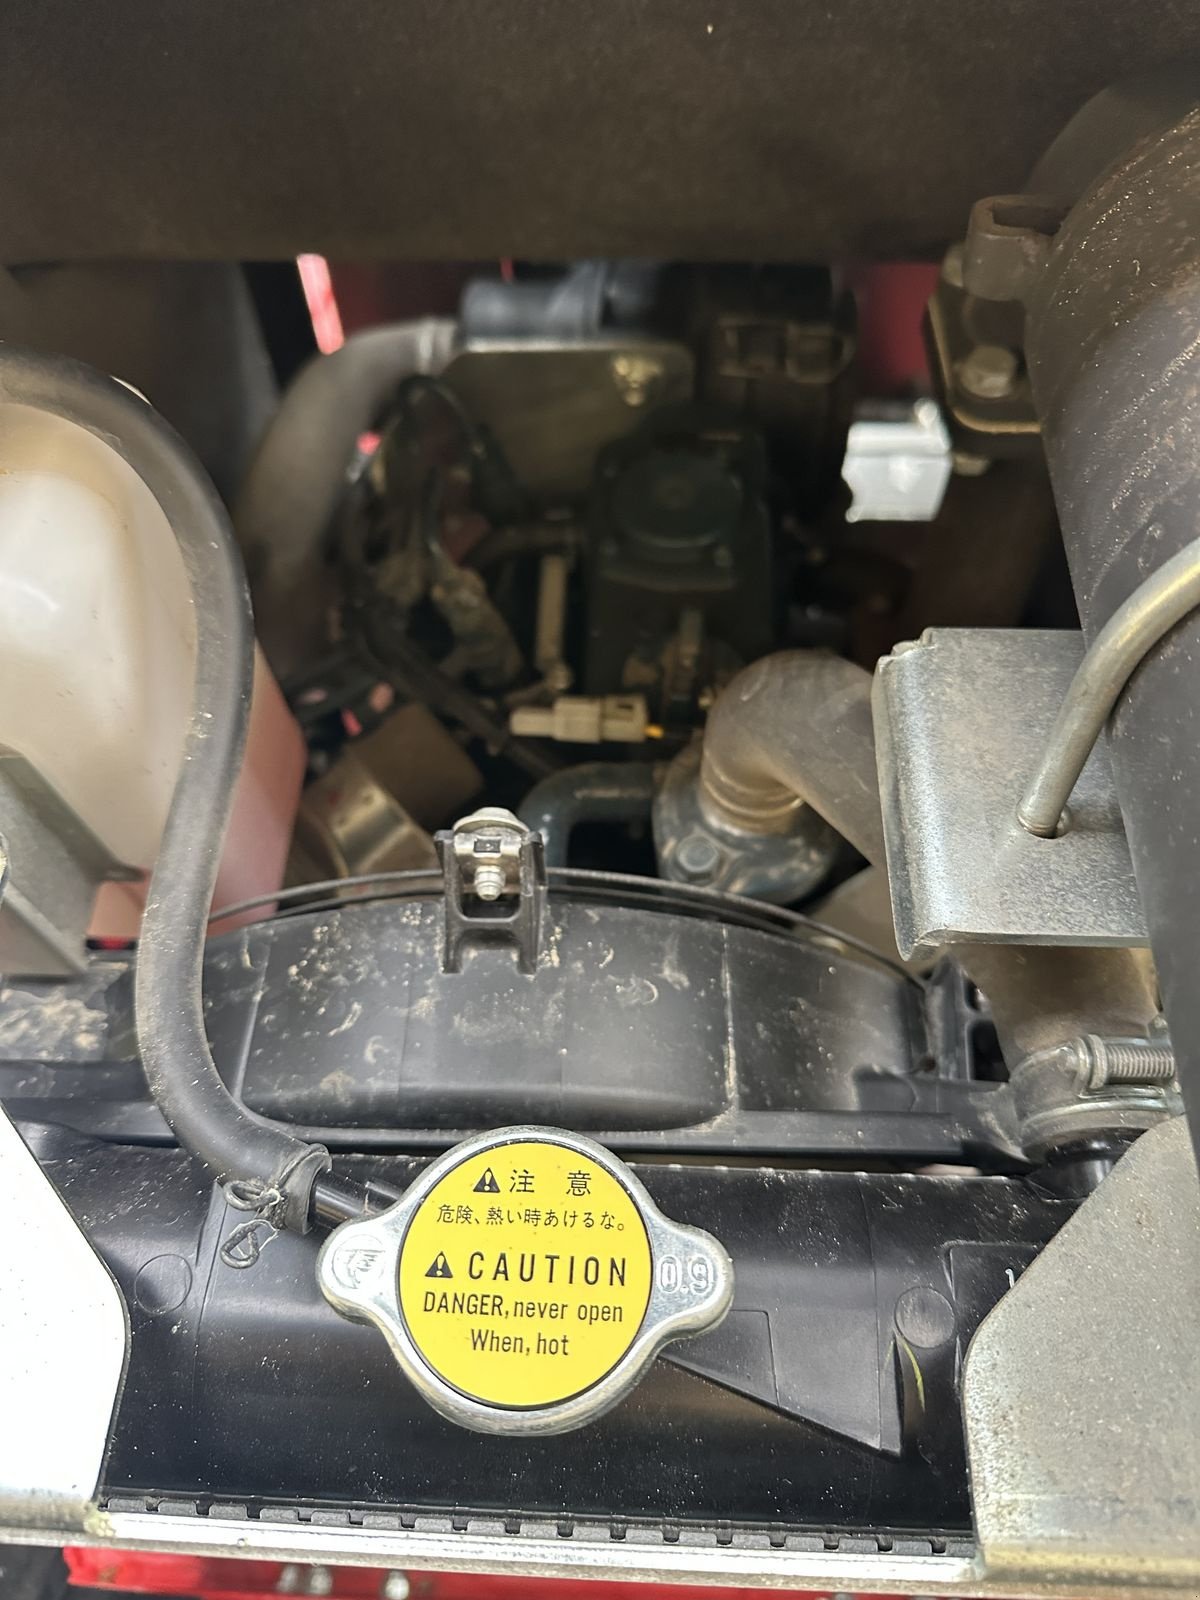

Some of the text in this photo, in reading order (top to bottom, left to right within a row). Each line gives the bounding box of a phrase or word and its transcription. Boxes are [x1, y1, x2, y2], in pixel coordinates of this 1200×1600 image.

[468, 1251, 626, 1287] CAUTION
[656, 1254, 714, 1296] 0.9
[513, 1300, 568, 1320] never
[577, 1303, 623, 1325] open
[471, 1328, 569, 1356] When, hot
